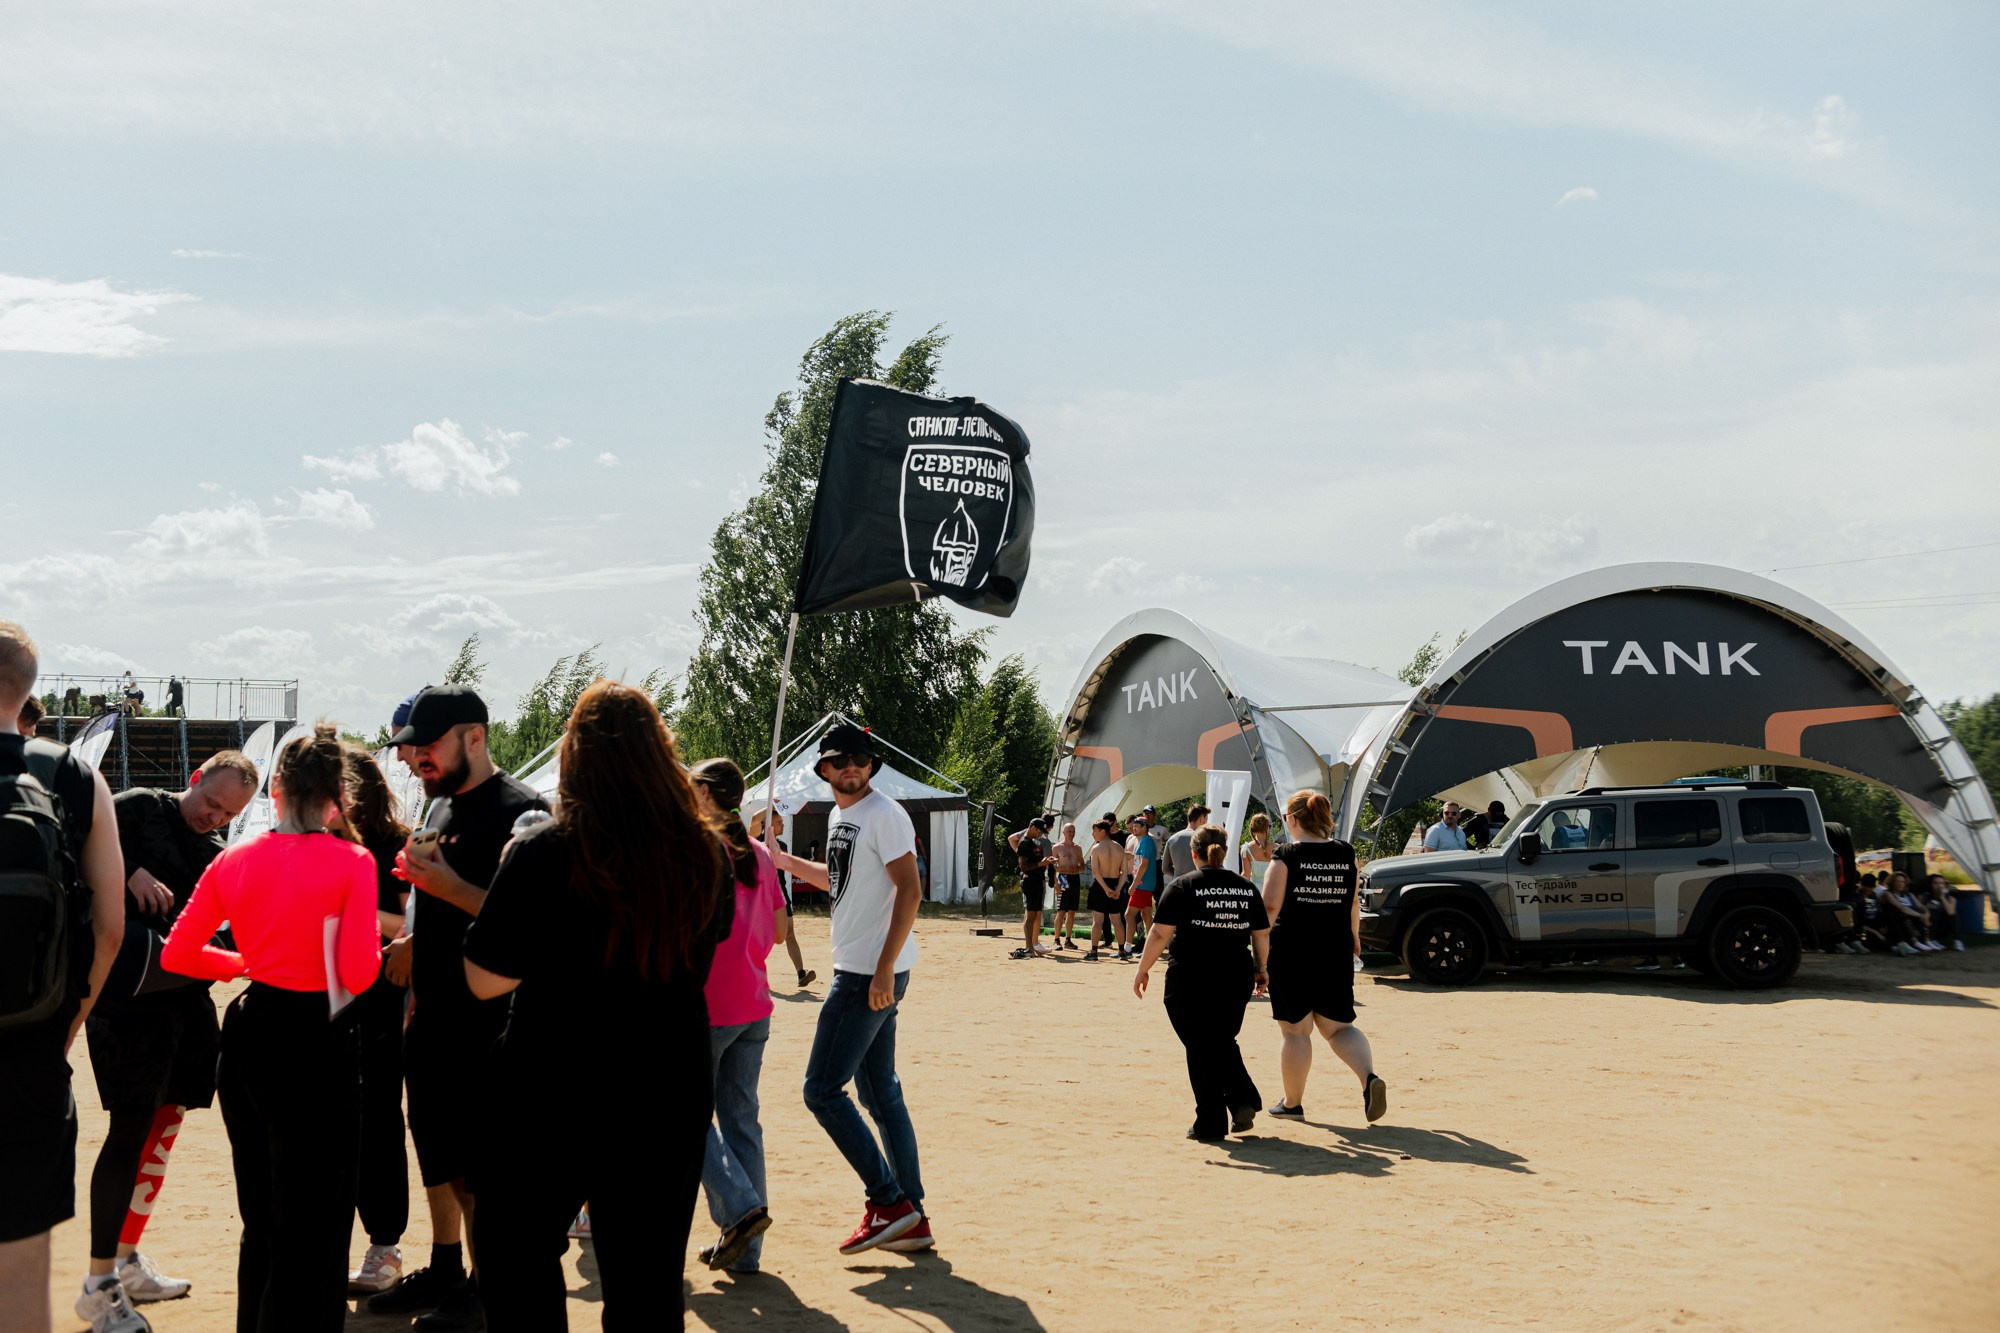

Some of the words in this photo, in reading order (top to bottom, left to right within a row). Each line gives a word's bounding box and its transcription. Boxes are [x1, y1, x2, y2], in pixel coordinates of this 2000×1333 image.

[909, 453, 1009, 484] СЕВЕРНЫЙ
[918, 475, 1005, 502] ЧЕЛОВЕК
[1562, 640, 1762, 676] TANK
[1121, 667, 1198, 714] TANK
[1300, 862, 1350, 871] МАССАЖНАЯ
[1305, 874, 1333, 883] МАГИЯ
[1293, 886, 1332, 895] АБХАЗИЯ
[1515, 880, 1578, 891] Тест-драйв
[1195, 887, 1254, 897] МАССАЖНАЯ
[1516, 894, 1574, 904] TANK
[1580, 893, 1624, 903] 300
[1206, 900, 1238, 909] МАГИЯ
